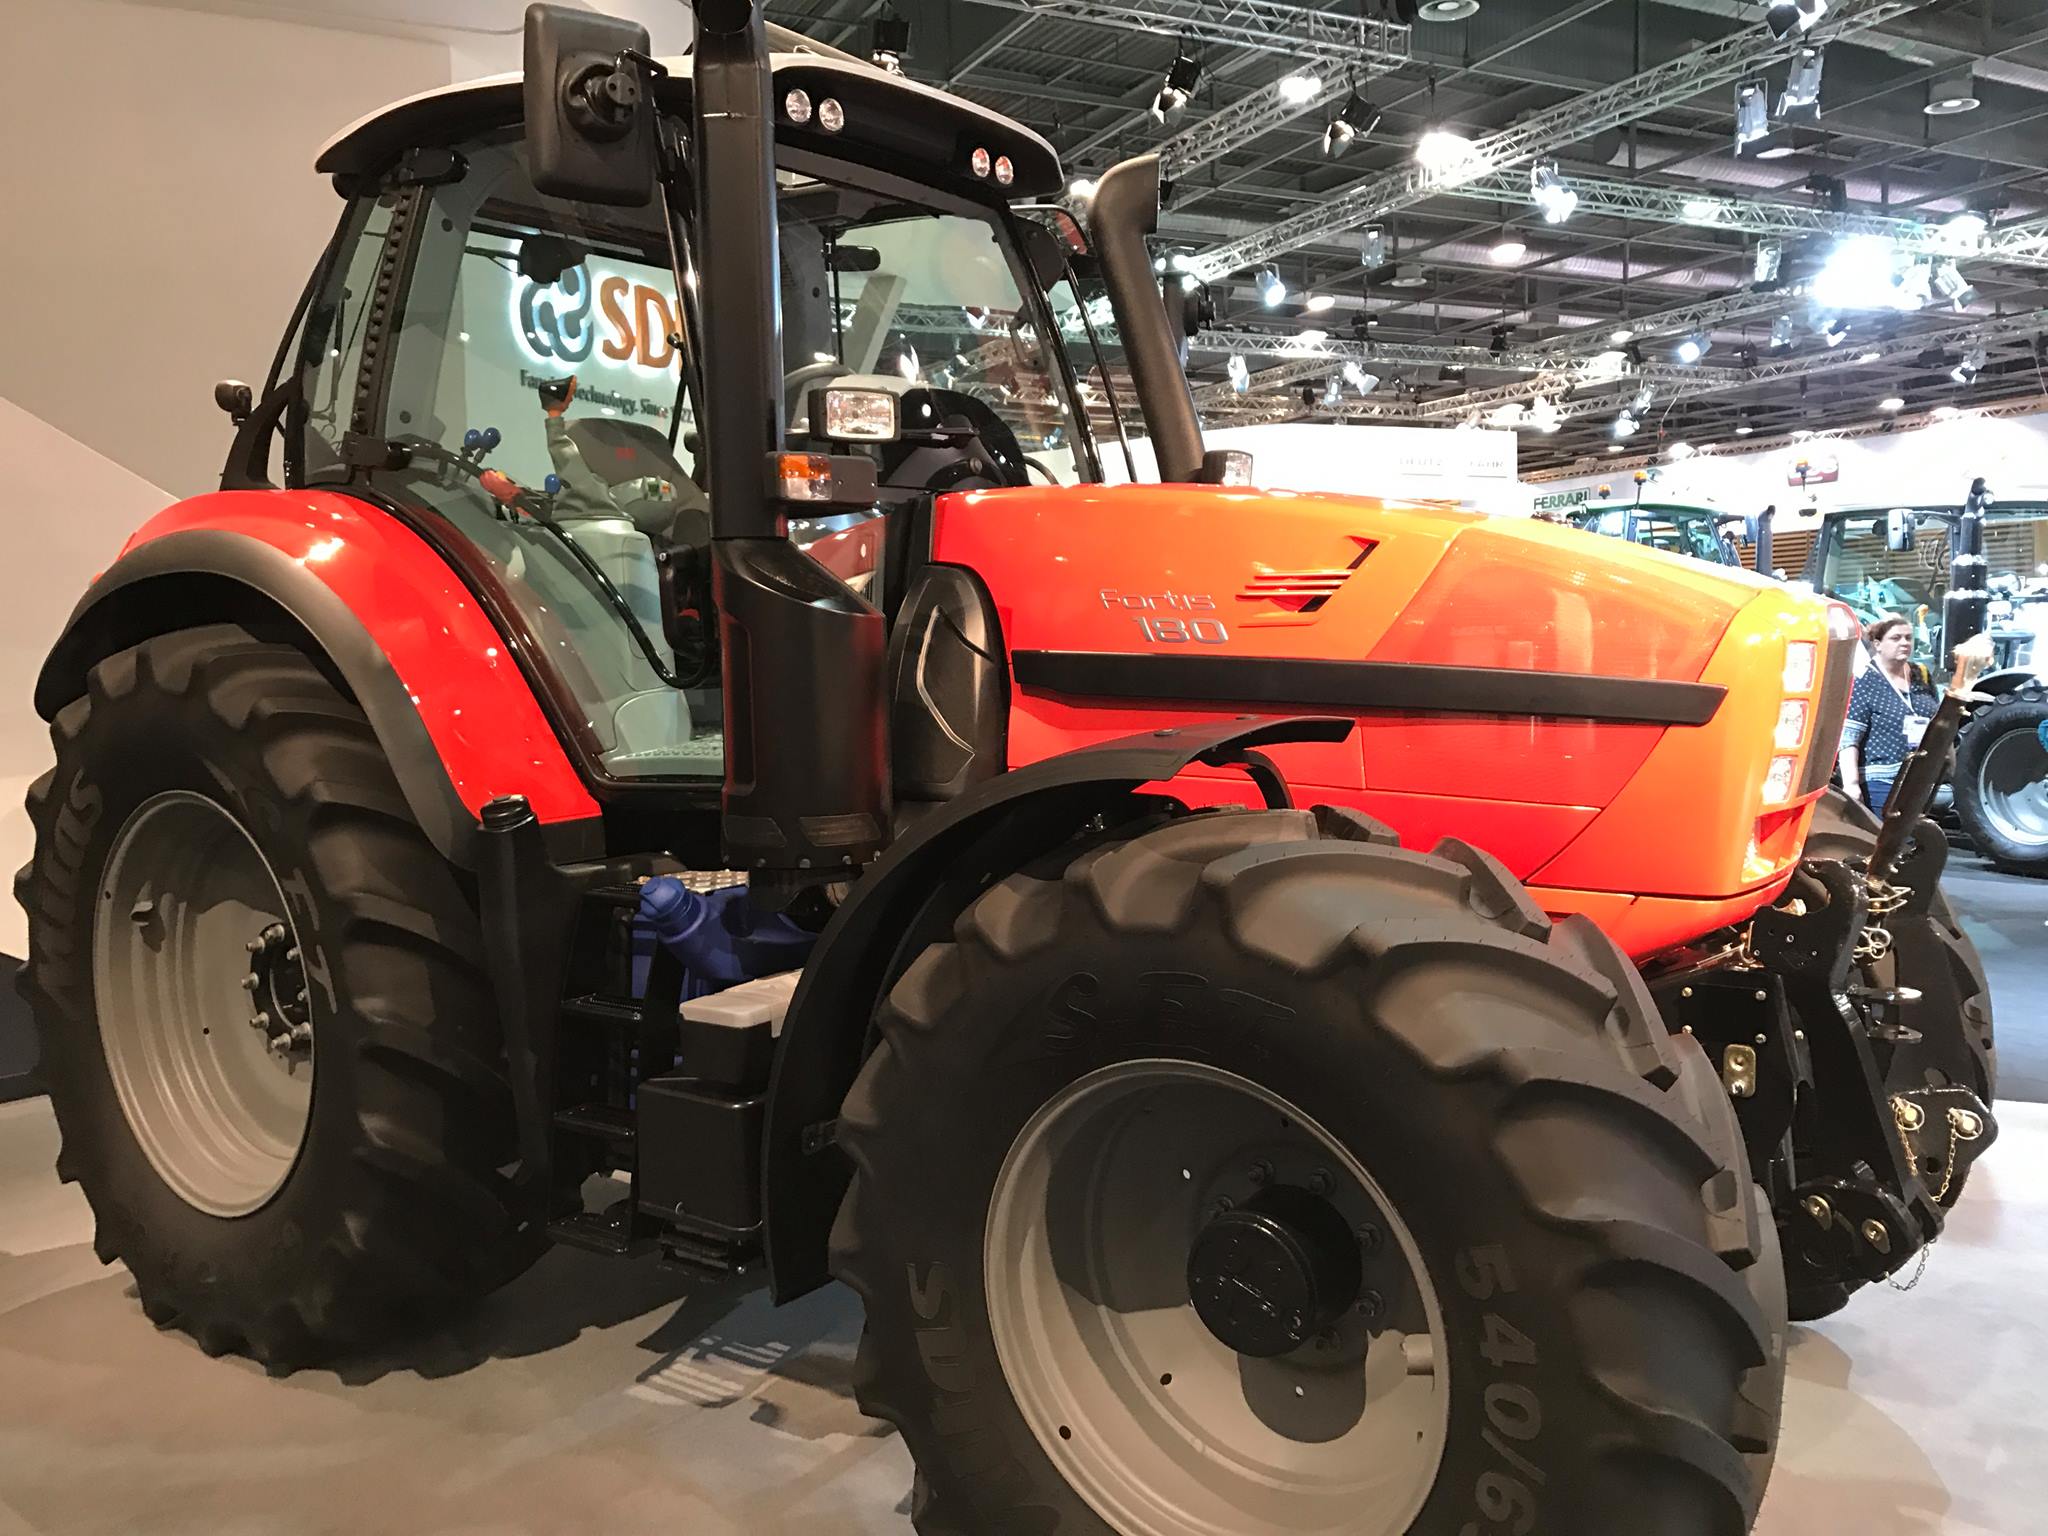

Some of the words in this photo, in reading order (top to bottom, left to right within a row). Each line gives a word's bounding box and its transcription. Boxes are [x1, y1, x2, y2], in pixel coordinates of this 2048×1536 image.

[575, 384, 638, 416] echnology.
[1533, 490, 1588, 510] FERRARI
[1099, 588, 1216, 610] Fortis
[1131, 616, 1229, 644] 180
[1455, 1244, 1546, 1536] 540/6
